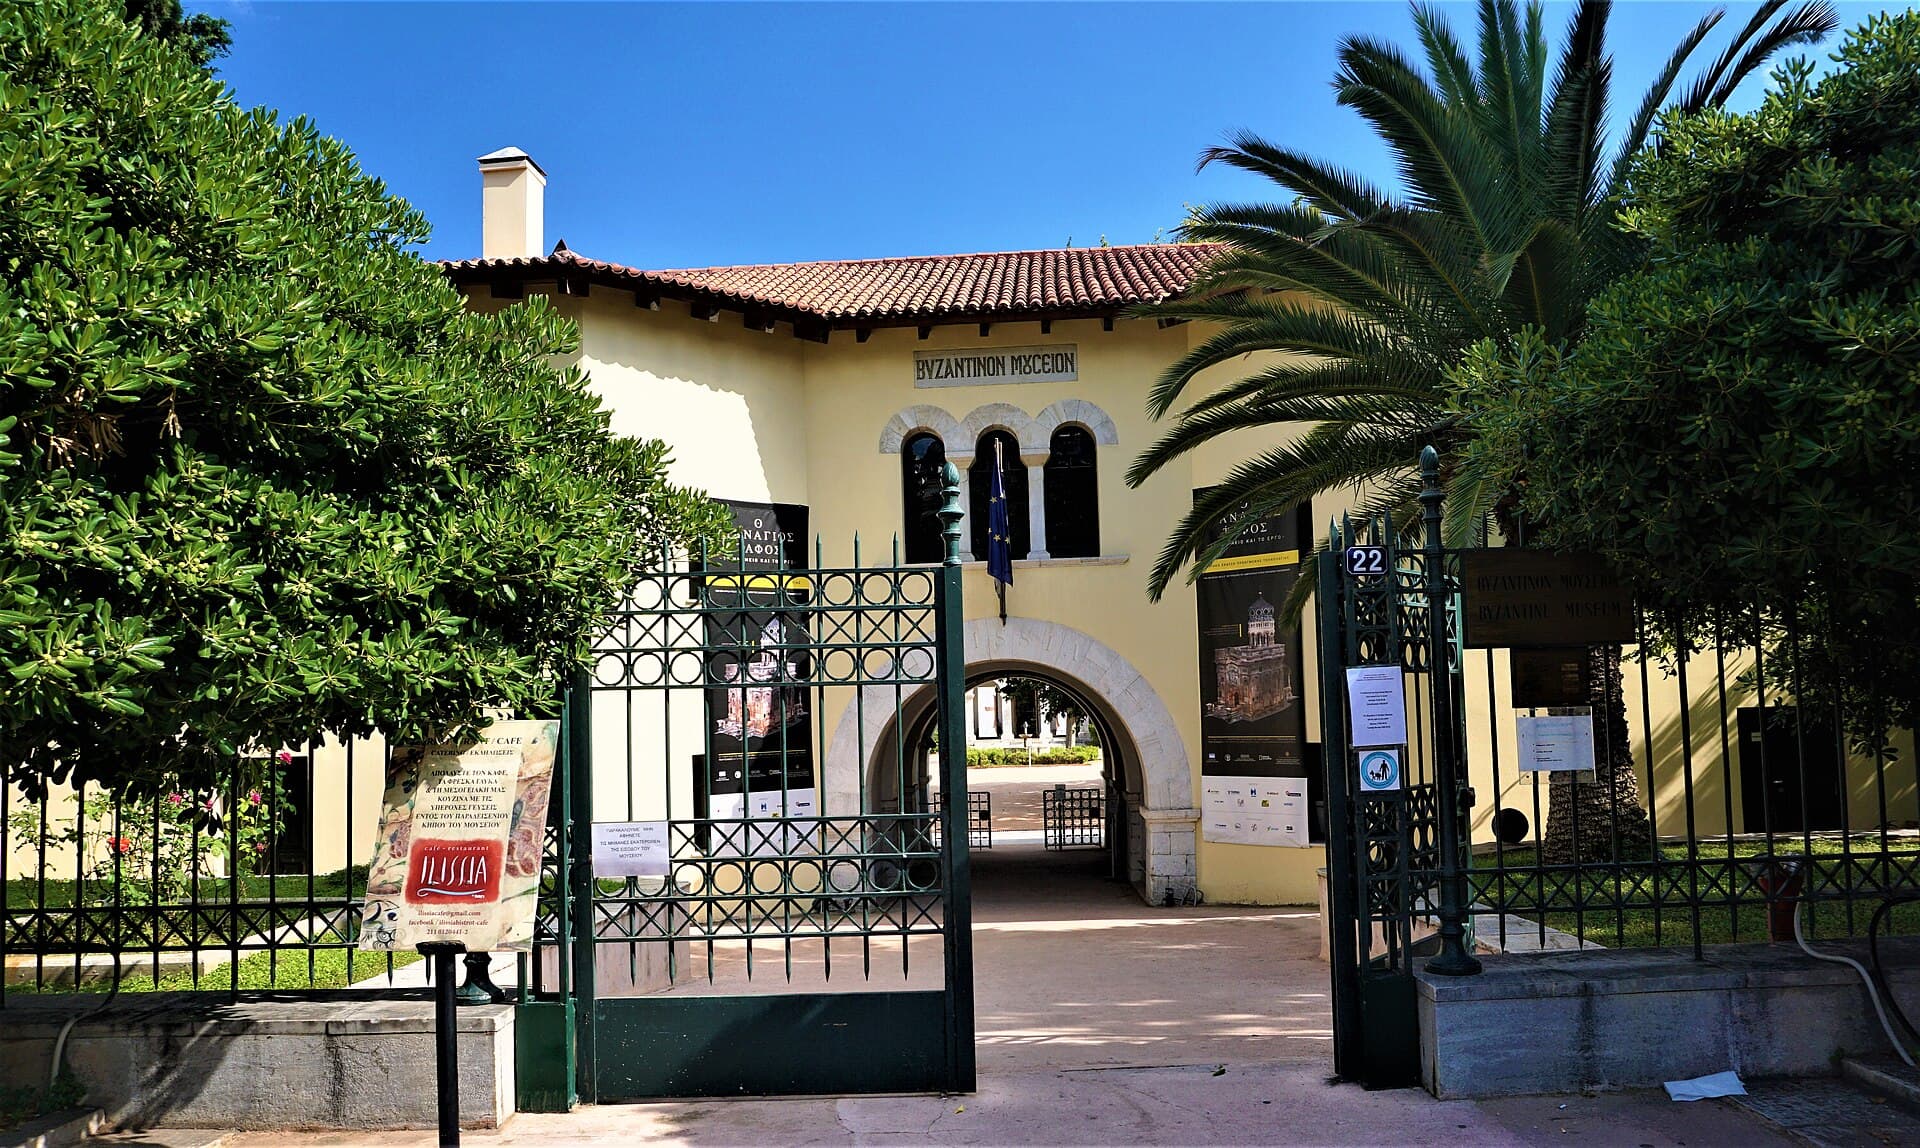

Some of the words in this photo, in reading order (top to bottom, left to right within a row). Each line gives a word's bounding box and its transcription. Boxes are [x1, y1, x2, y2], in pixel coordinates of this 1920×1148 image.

[1353, 549, 1382, 571] 22
[1565, 601, 1621, 618] MUSEUM
[421, 855, 487, 887] ILISSIA
